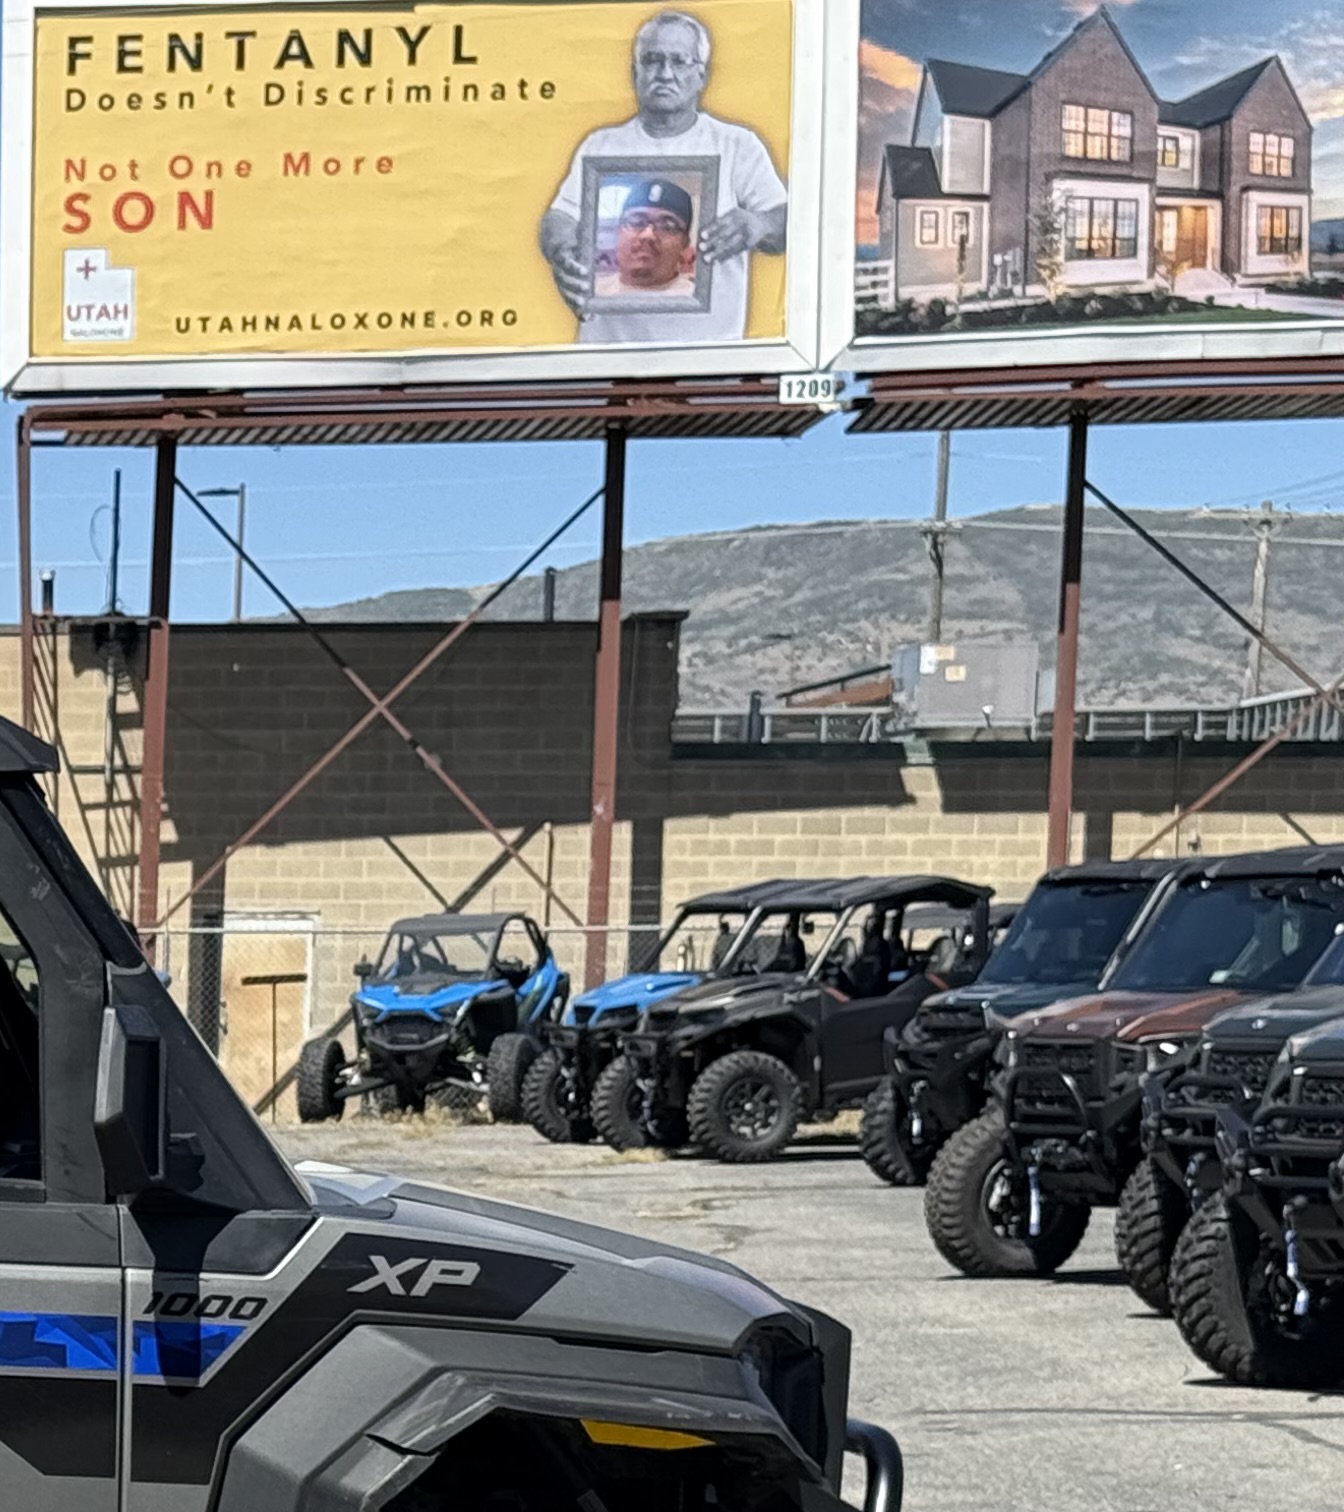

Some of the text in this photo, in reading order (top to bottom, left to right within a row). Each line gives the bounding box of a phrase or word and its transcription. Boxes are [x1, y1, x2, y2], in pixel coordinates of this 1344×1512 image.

[67, 24, 479, 76] FENTANYL
[65, 76, 557, 112] Doesn't Discriminate
[64, 151, 394, 183] Not One More
[62, 189, 215, 234] SON
[67, 303, 129, 322] UTAH
[175, 308, 518, 334] UTAHNALOXONE.ORG
[786, 378, 831, 398] 1209
[346, 1255, 481, 1297] XP
[142, 1292, 268, 1320] 1000
